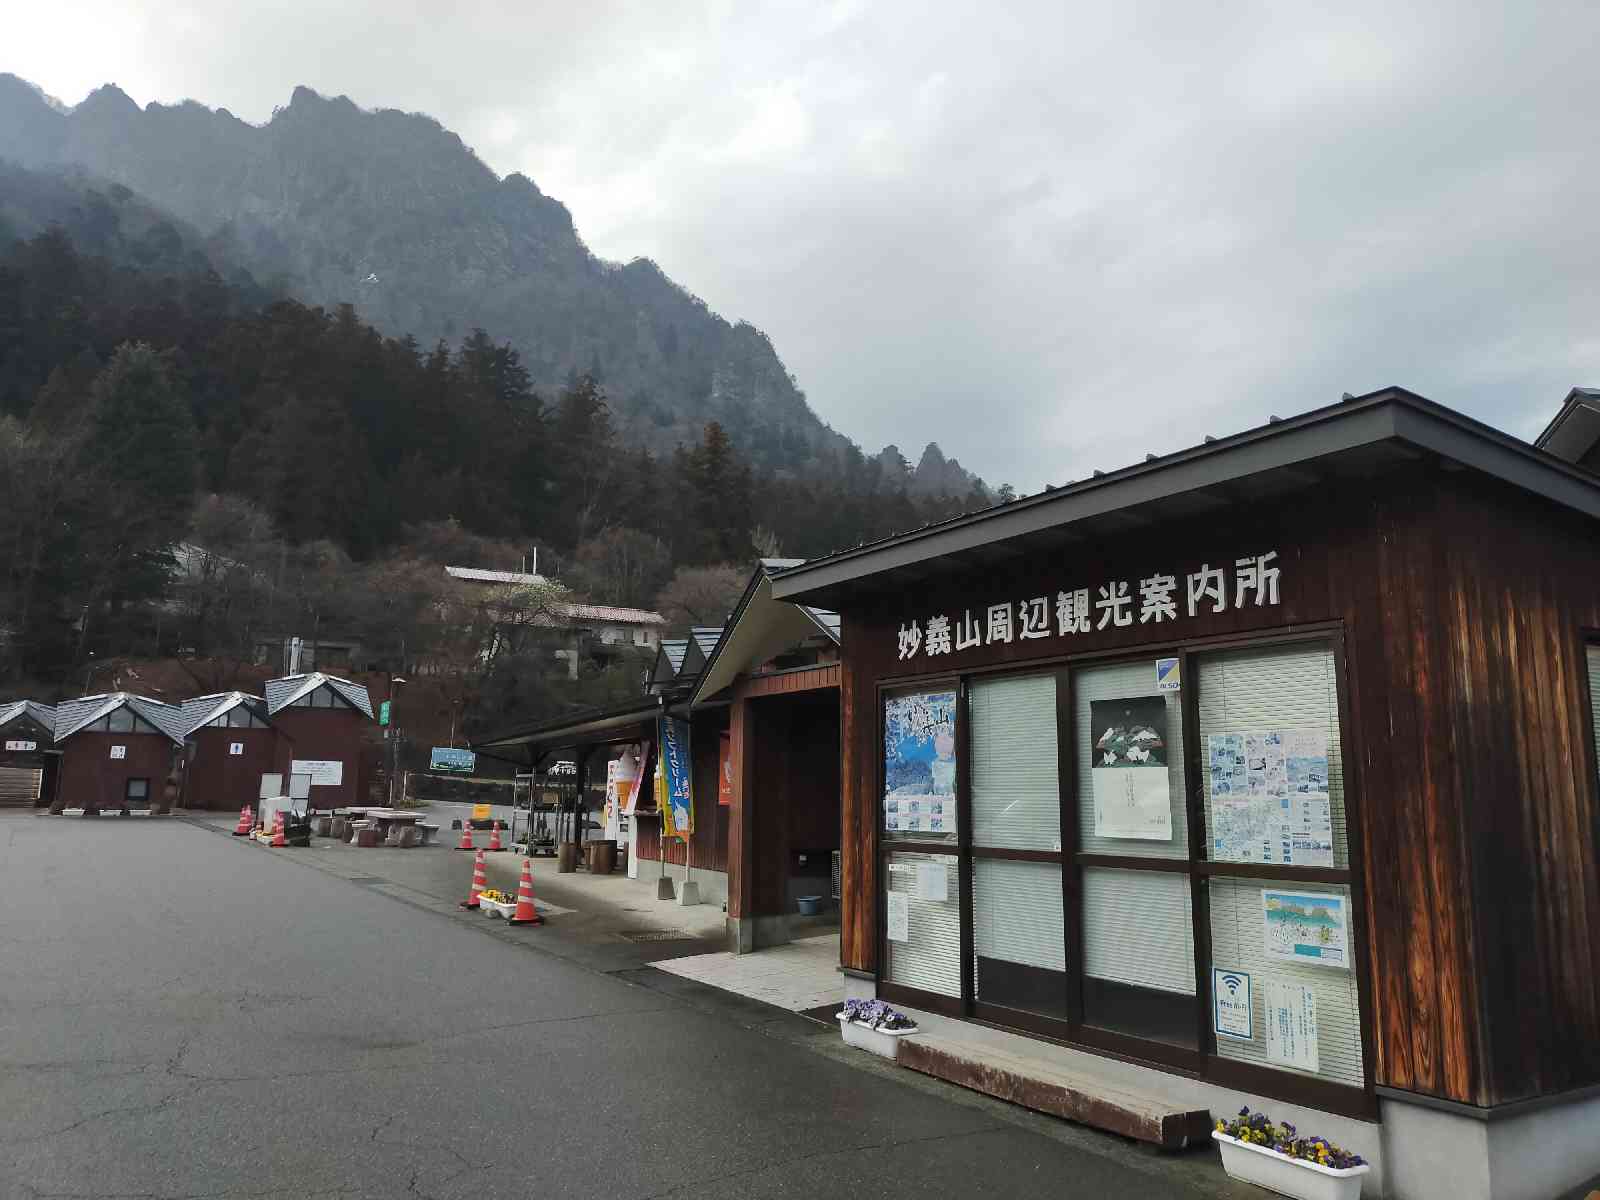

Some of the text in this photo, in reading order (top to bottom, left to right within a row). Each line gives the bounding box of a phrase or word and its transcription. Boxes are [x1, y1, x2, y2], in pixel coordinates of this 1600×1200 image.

[898, 550, 1280, 661] 妙義山周辺観光案内所
